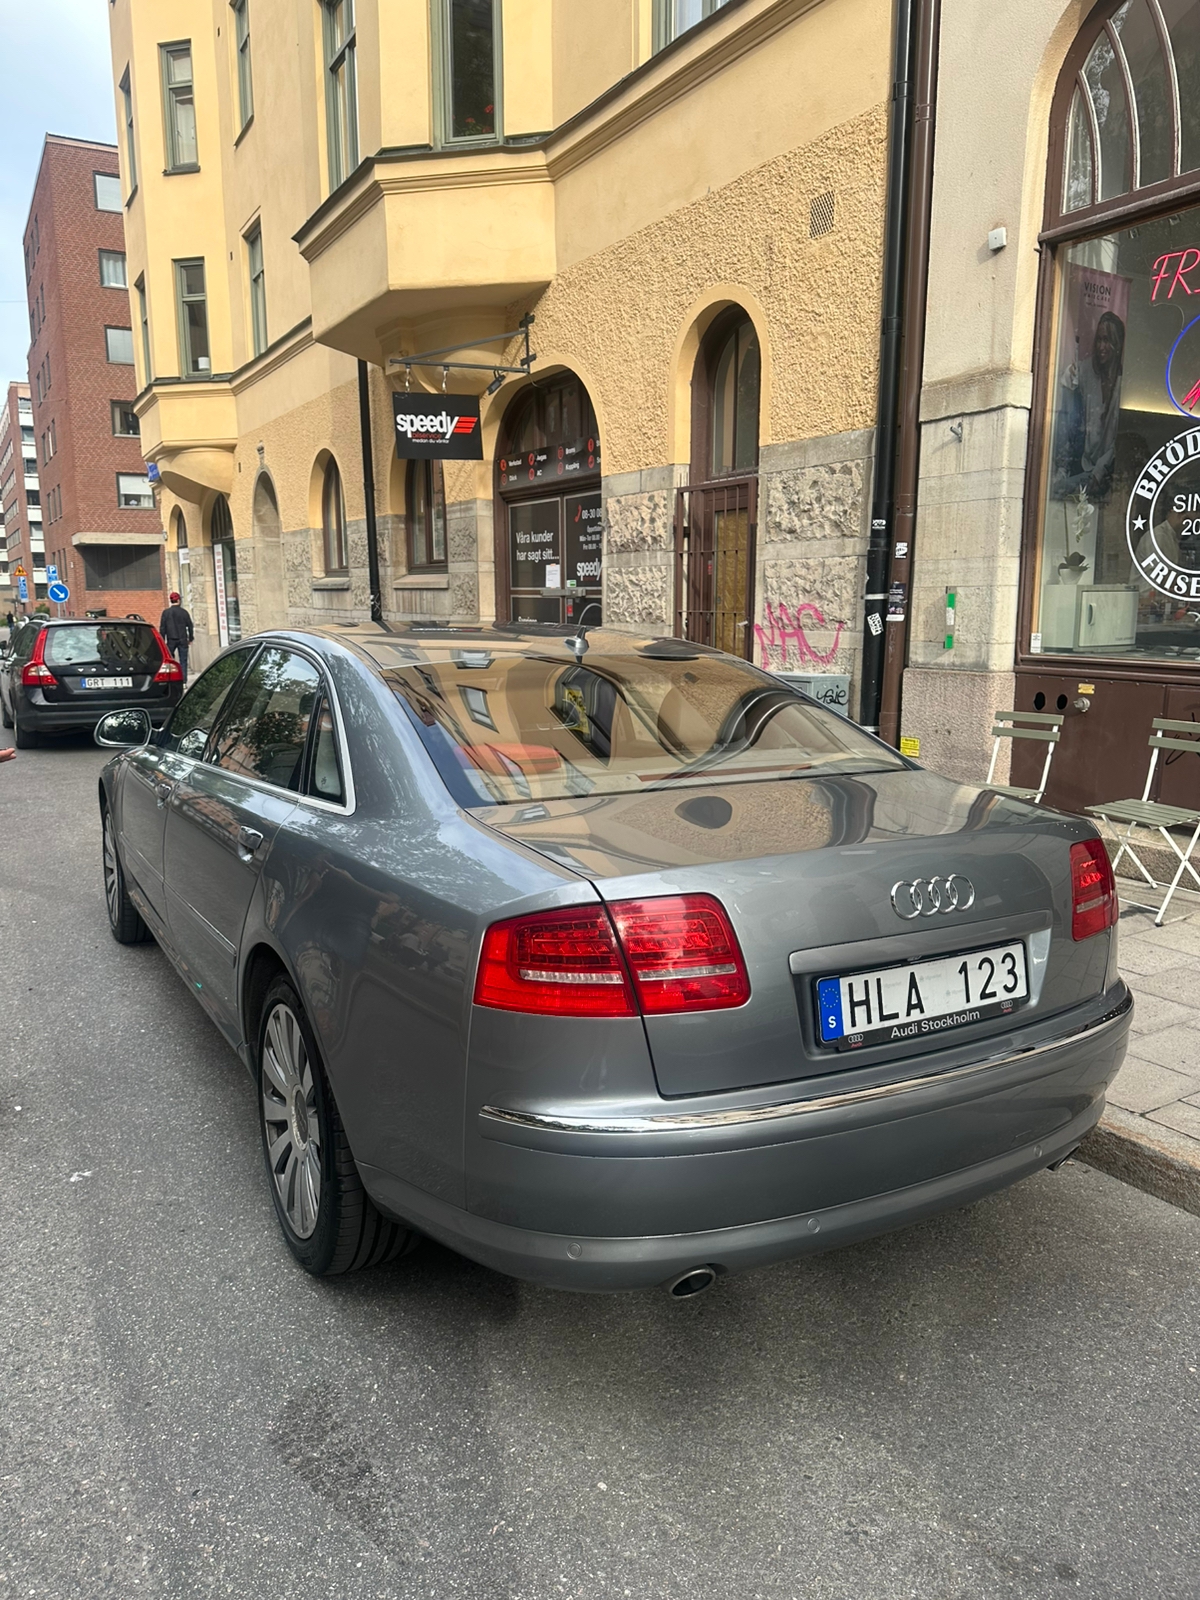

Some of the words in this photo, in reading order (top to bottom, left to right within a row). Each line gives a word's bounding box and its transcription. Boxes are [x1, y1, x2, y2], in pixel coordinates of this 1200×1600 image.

[1151, 248, 1200, 302] FR
[1084, 281, 1111, 296] VISION
[396, 411, 460, 439] speedy
[1181, 518, 1200, 536] 20
[515, 531, 530, 544] Våra
[531, 530, 554, 543] kunder
[516, 549, 527, 561] har
[527, 548, 542, 563] sagt
[49, 565, 56, 574] P
[576, 557, 602, 582] speedy
[86, 678, 105, 687] GRT
[113, 678, 130, 686] 111
[847, 971, 925, 1028] HLA
[958, 952, 1020, 1004] 123
[828, 1015, 837, 1029] S
[890, 1023, 919, 1039] Audi
[921, 1010, 980, 1032] Stockholm
